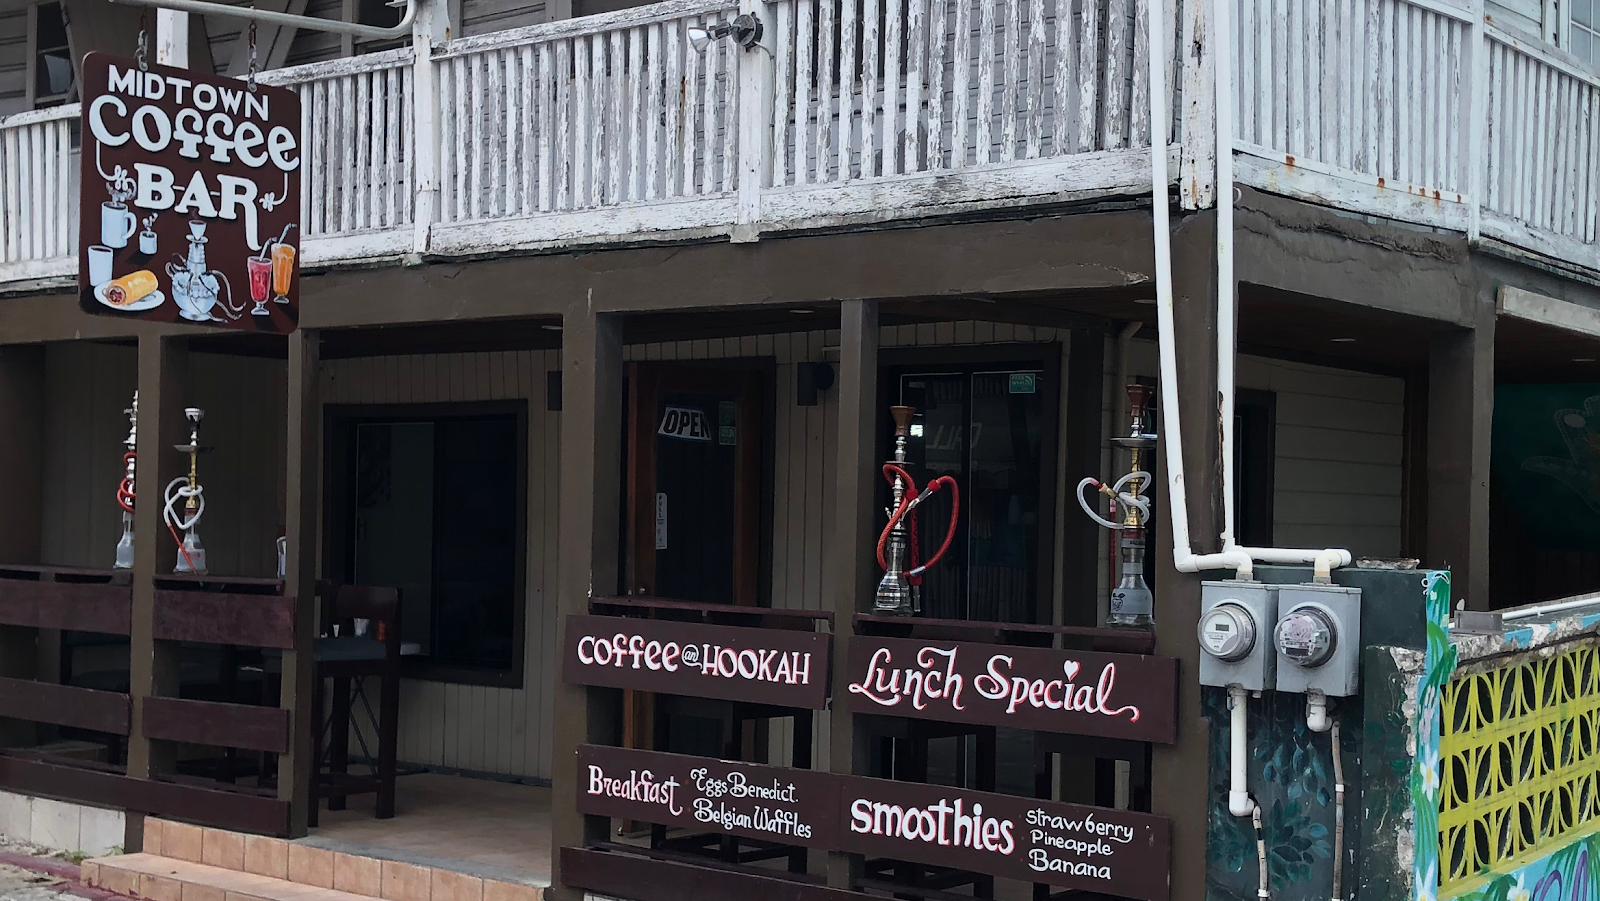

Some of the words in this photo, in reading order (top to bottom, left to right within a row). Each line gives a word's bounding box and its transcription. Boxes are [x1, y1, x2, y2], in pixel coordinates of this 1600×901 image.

[108, 64, 269, 121] MIDTOWN
[663, 409, 710, 438] OPEN
[701, 643, 811, 685] HOOKAH
[849, 645, 965, 711] Lunch
[974, 654, 1140, 723] Special
[587, 764, 684, 816] Breakfast
[690, 767, 728, 798] Eggs
[692, 798, 752, 830] Belgian
[753, 805, 812, 839] Waffles
[1029, 829, 1114, 857] Pineapple
[1028, 848, 1112, 880] Banana
